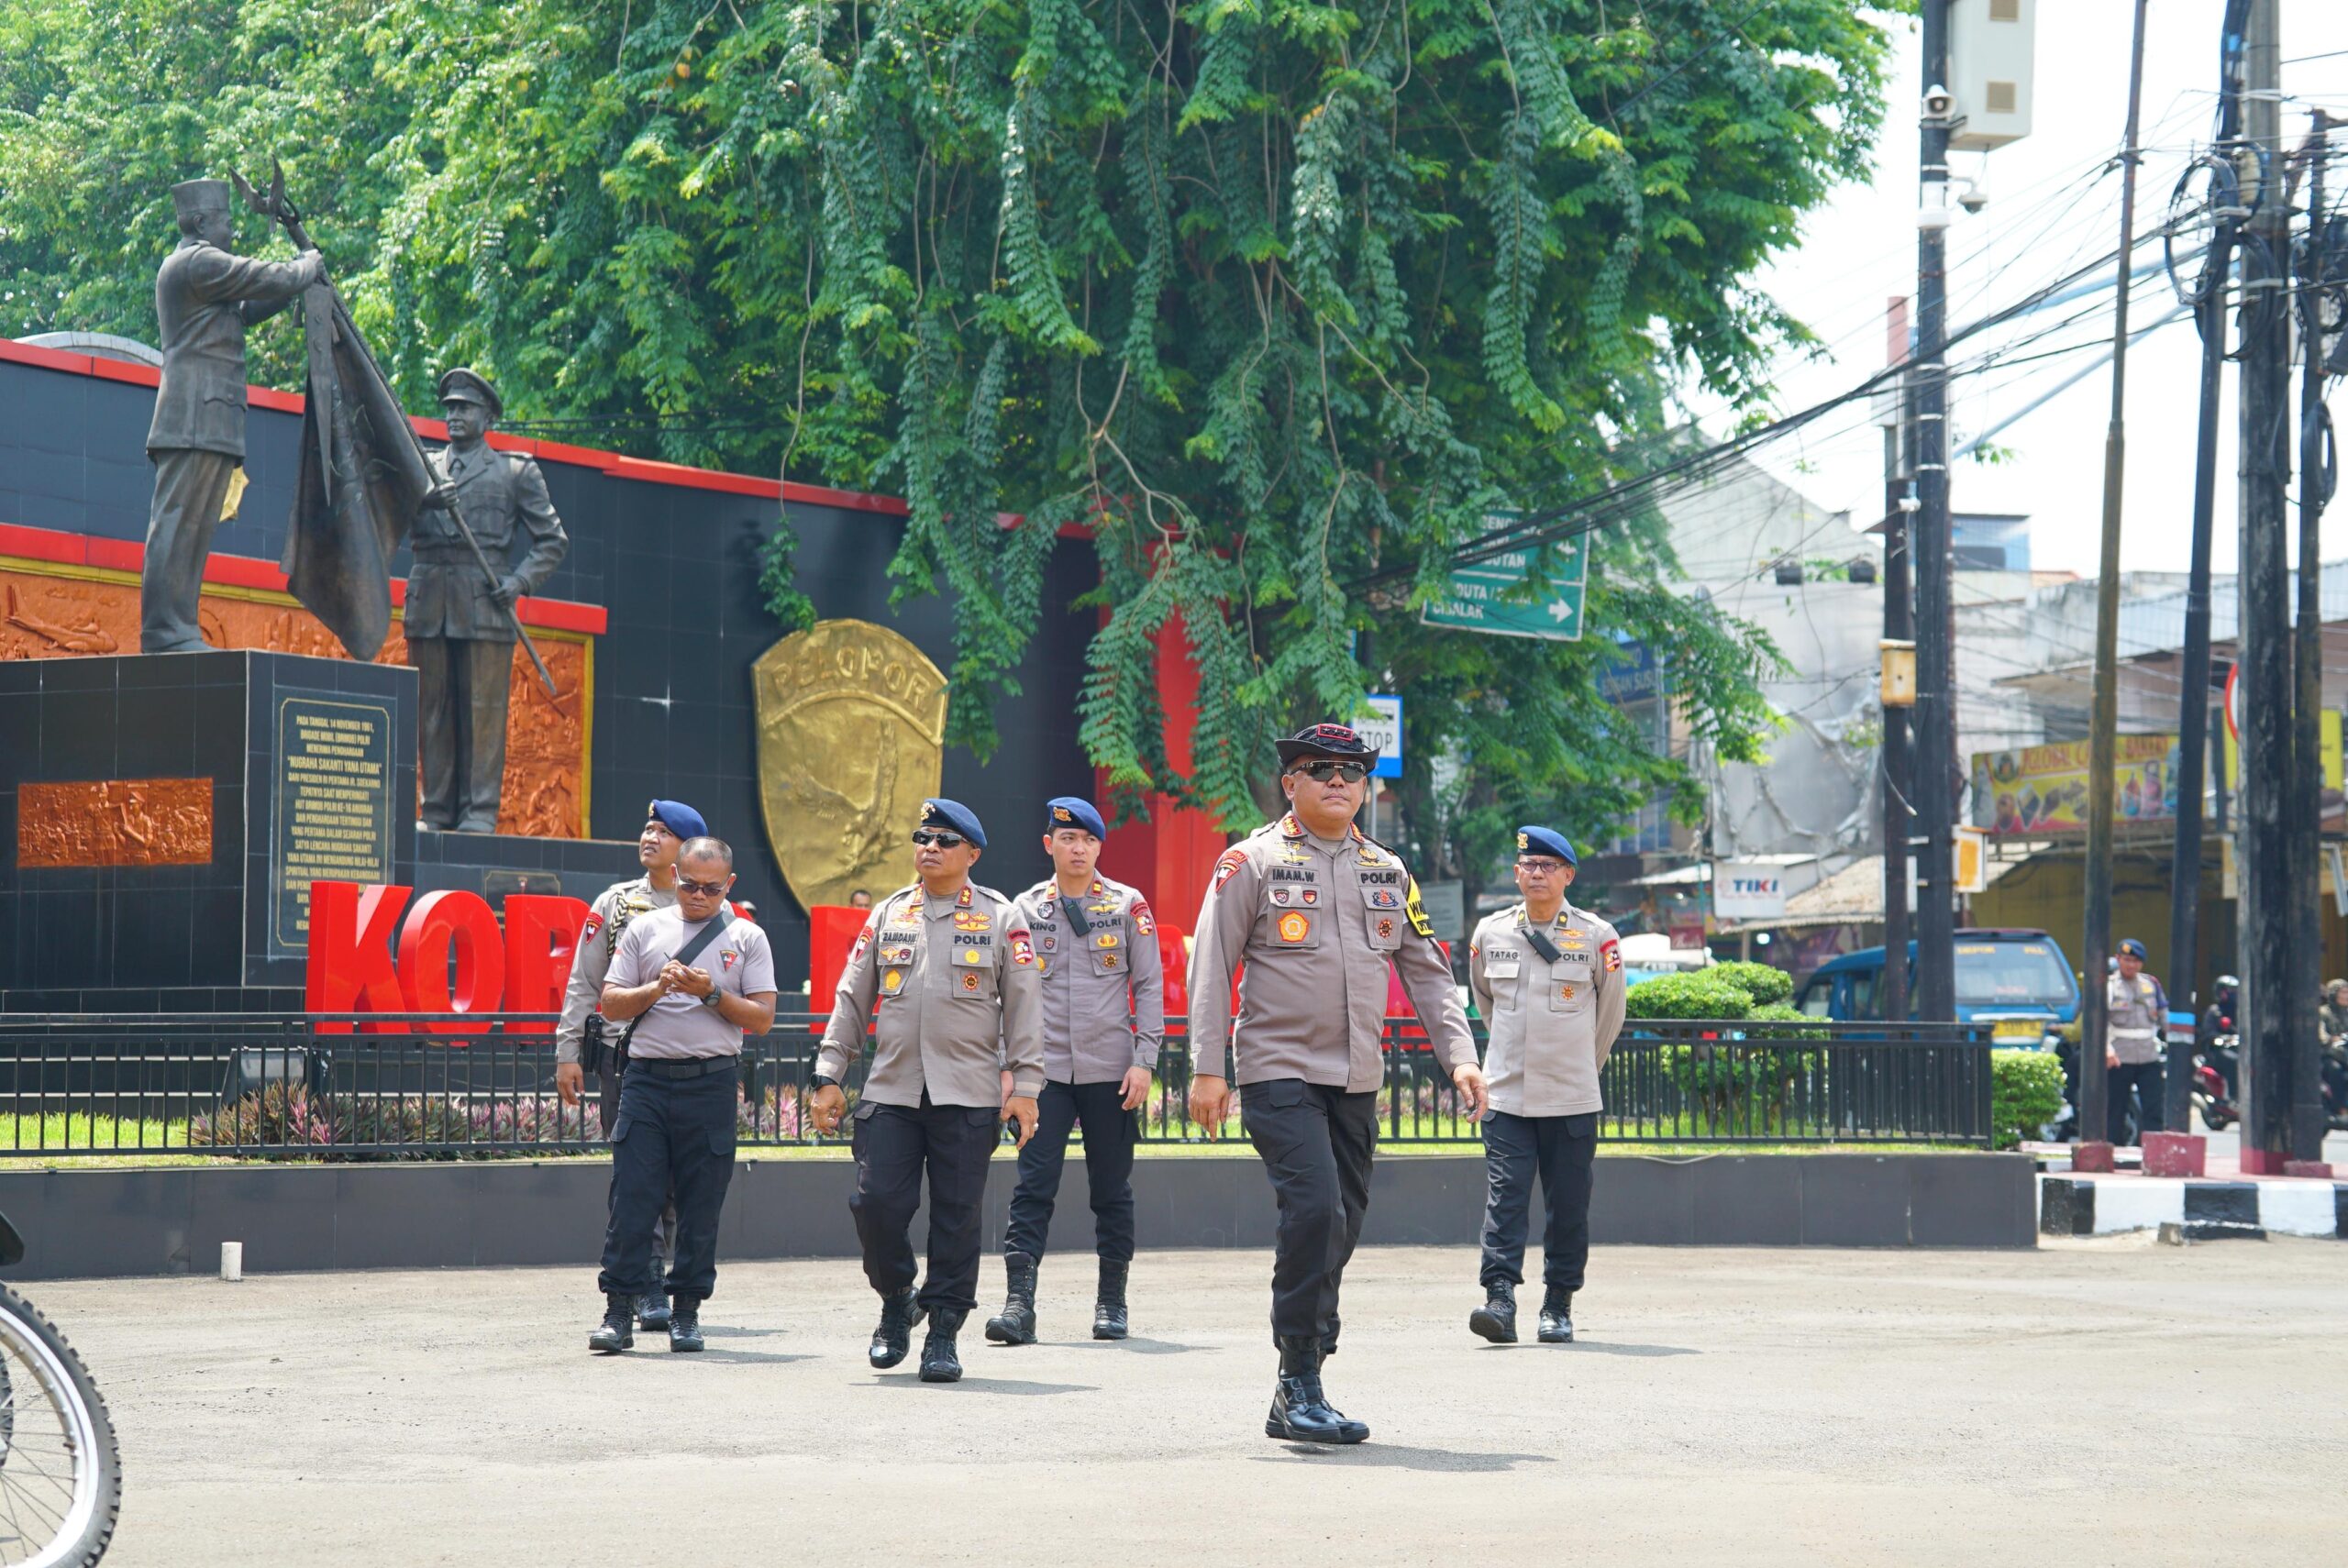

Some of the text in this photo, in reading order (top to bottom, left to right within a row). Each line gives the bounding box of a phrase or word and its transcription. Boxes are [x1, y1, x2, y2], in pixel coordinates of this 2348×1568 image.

[772, 646, 931, 713] PELOPOR
[344, 759, 360, 773] YANA
[1272, 868, 1314, 882] IMAM.W
[1360, 872, 1397, 884] POLRI
[1733, 879, 1778, 893] TIKI
[1090, 918, 1122, 929] POLRI
[954, 934, 991, 945] POLRI
[1490, 950, 1519, 960] TATAG
